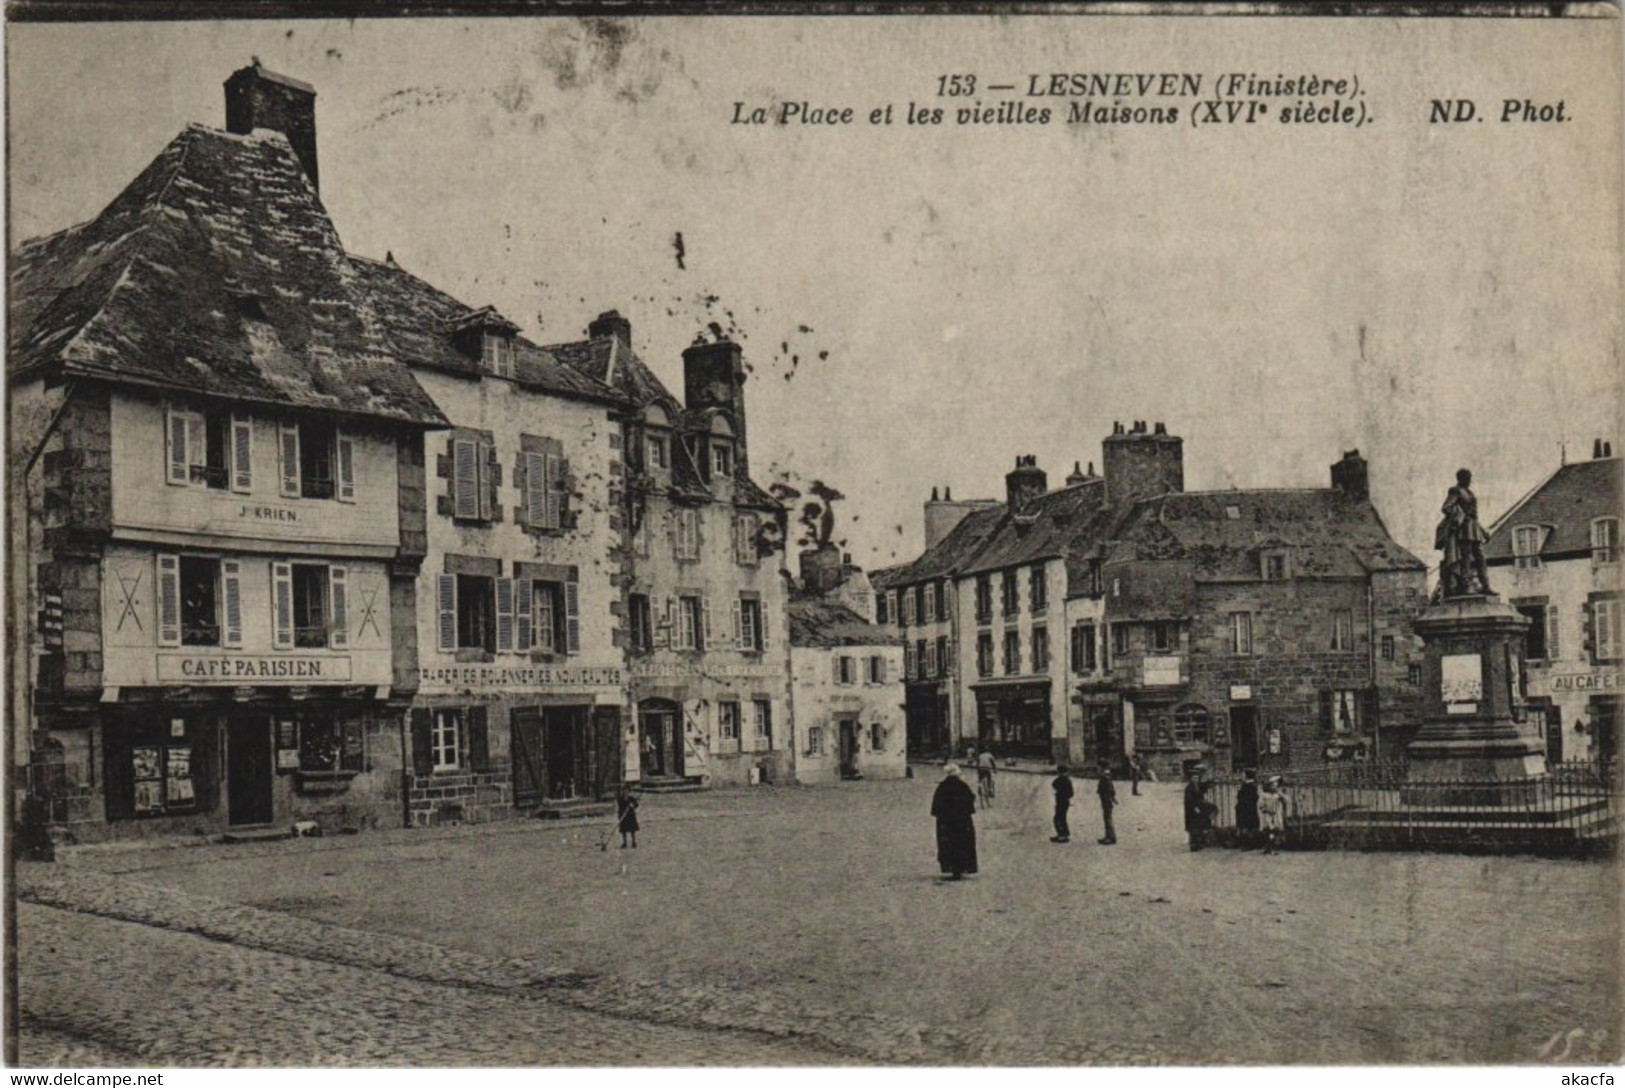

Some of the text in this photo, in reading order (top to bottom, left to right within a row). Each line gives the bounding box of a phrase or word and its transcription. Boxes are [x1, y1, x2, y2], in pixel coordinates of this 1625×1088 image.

[235, 659, 321, 677] PARISIEN
[417, 667, 477, 685] RAPERIES
[1555, 677, 1573, 690] AU
